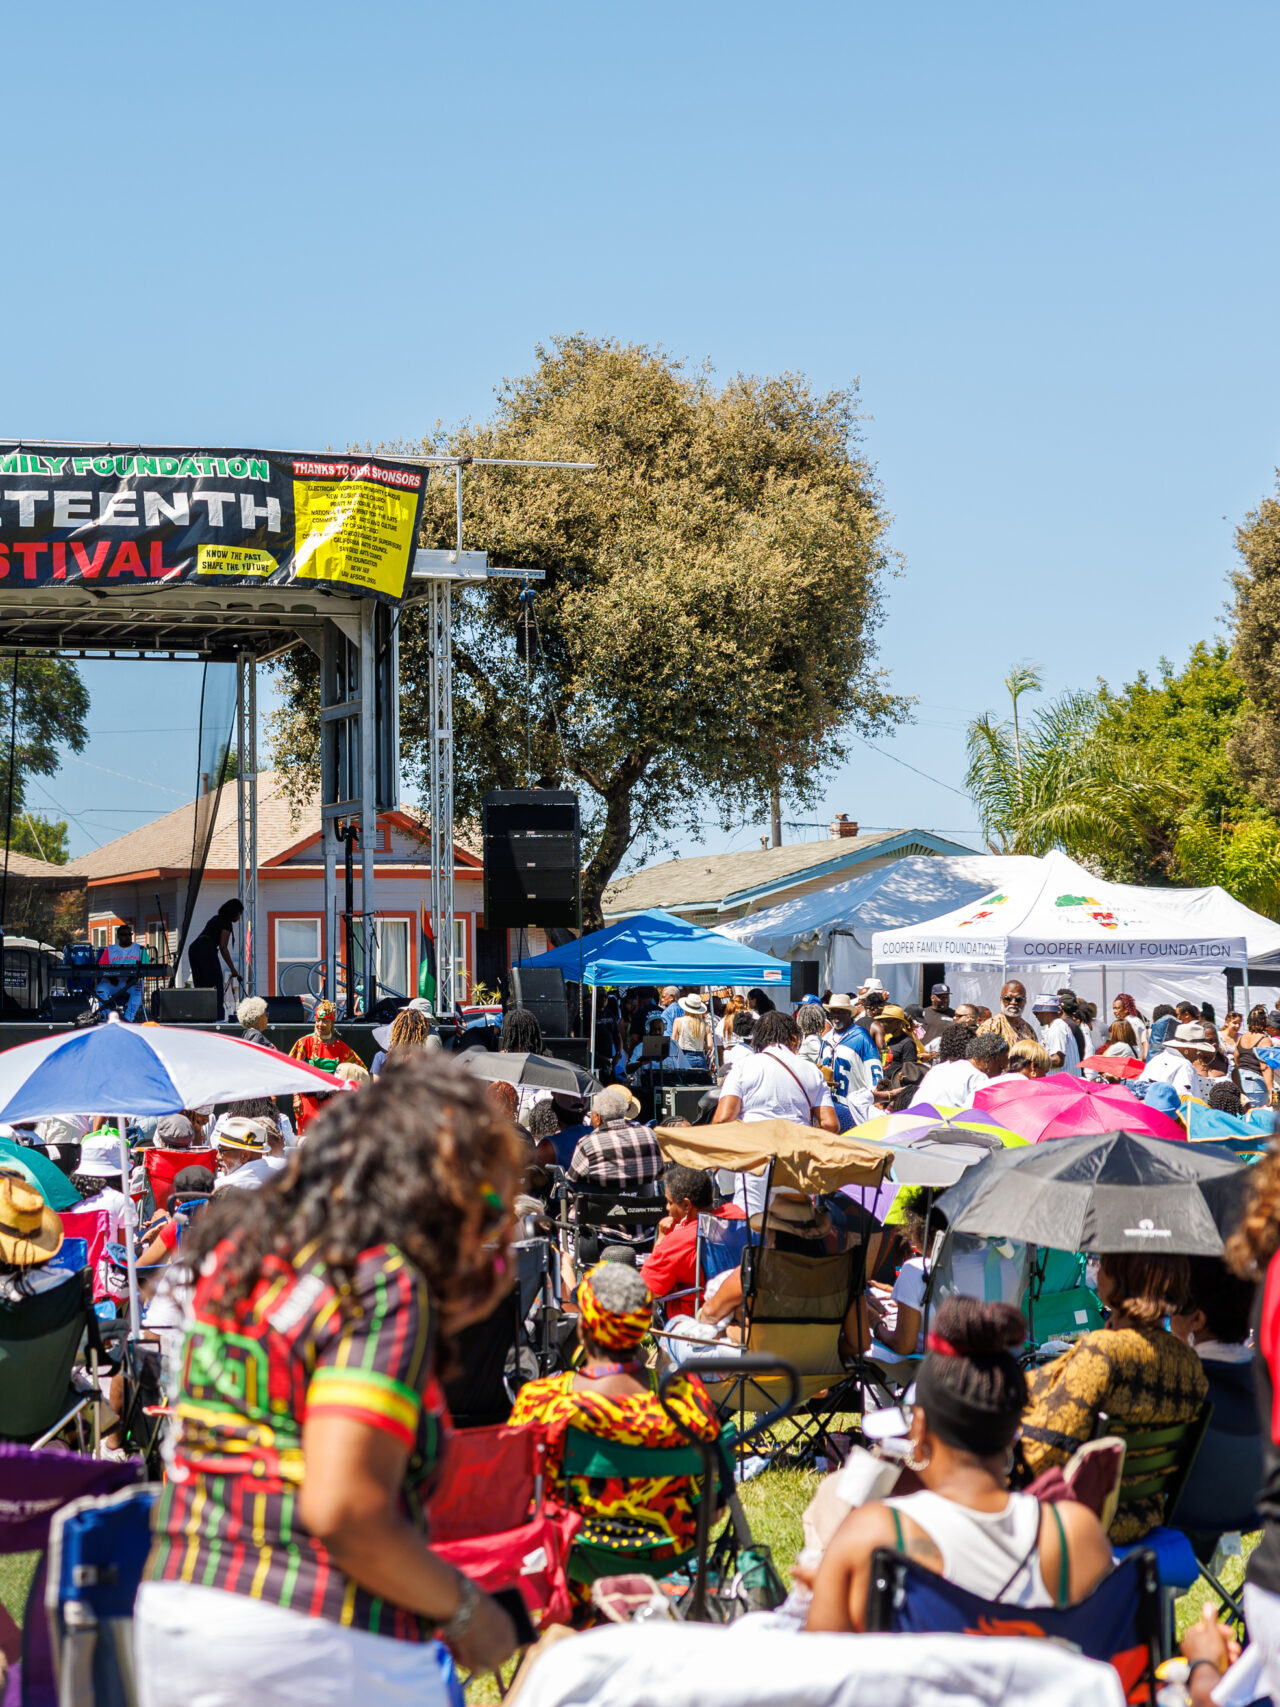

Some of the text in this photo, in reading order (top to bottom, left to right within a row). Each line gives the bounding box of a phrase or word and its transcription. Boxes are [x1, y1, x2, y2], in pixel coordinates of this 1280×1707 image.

[71, 455, 270, 482] FOUNDATION
[294, 463, 420, 487] THANKS TO OUR SPONSORS
[206, 549, 261, 561] KNOW THE PAST
[202, 561, 270, 573] SHAPE THE FUTURE
[882, 941, 996, 956] COOPER FAMILY FOUNDATION
[1023, 942, 1231, 957] COOPER FAMILY FOUNDATION
